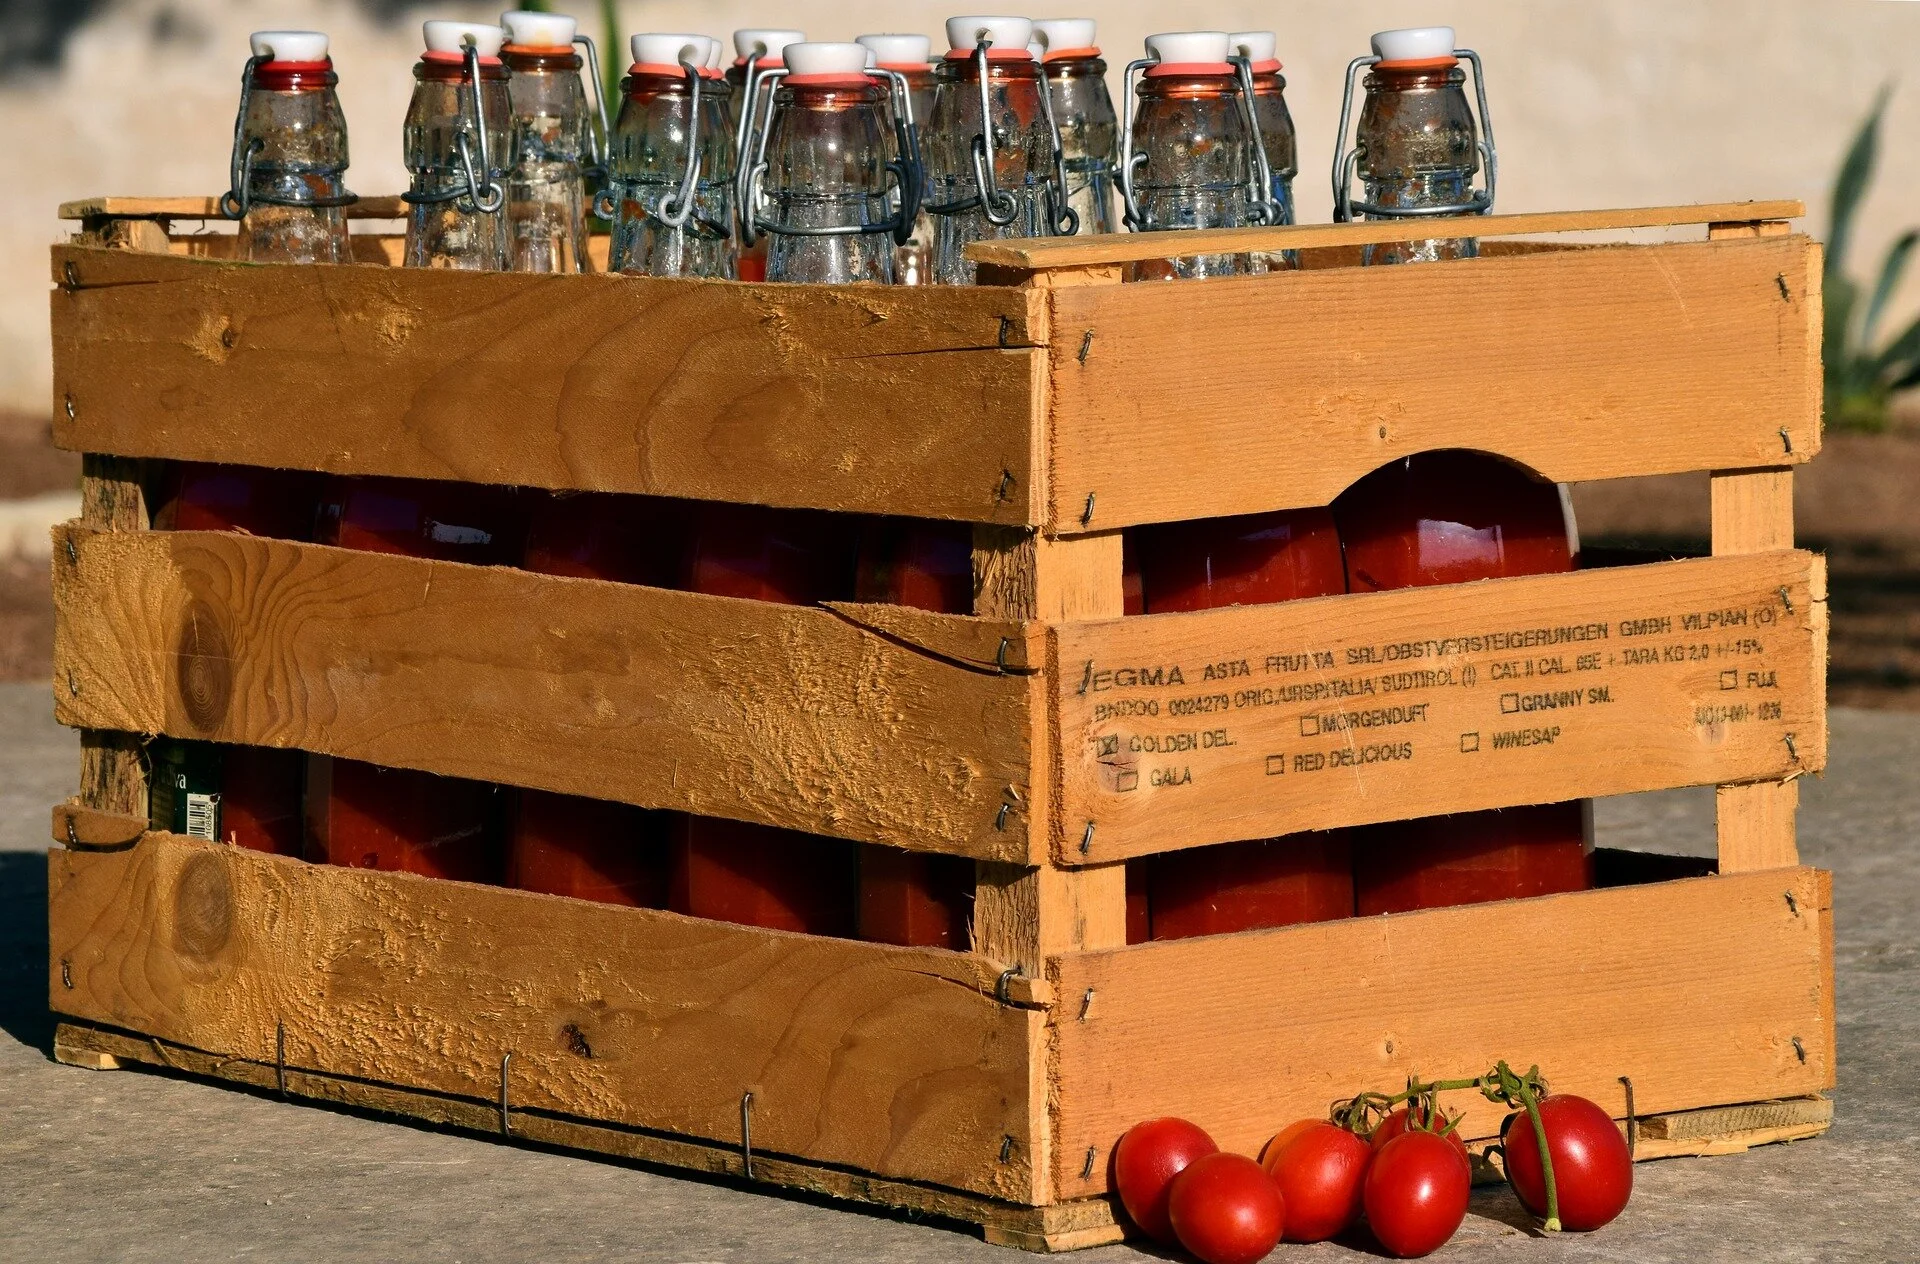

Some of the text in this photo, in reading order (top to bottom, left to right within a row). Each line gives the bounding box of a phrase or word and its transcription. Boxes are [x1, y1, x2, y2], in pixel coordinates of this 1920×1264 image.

[1203, 659, 1251, 681] ASTA
[1266, 651, 1335, 675] FRUTTA
[1619, 616, 1672, 637] GMBH
[1682, 609, 1748, 631] VILPIAN
[1168, 693, 1230, 717] 0024279
[1623, 648, 1660, 666] TARA
[1663, 645, 1685, 663] KG
[1521, 685, 1615, 712] GRANNY SM.
[1321, 702, 1430, 733] MORGENDUFT
[1129, 728, 1238, 754] GOLDEN DEL.
[1492, 726, 1561, 750] WINESAP
[1294, 741, 1413, 772] RED DELICIOUS
[1150, 766, 1192, 787] GALA
